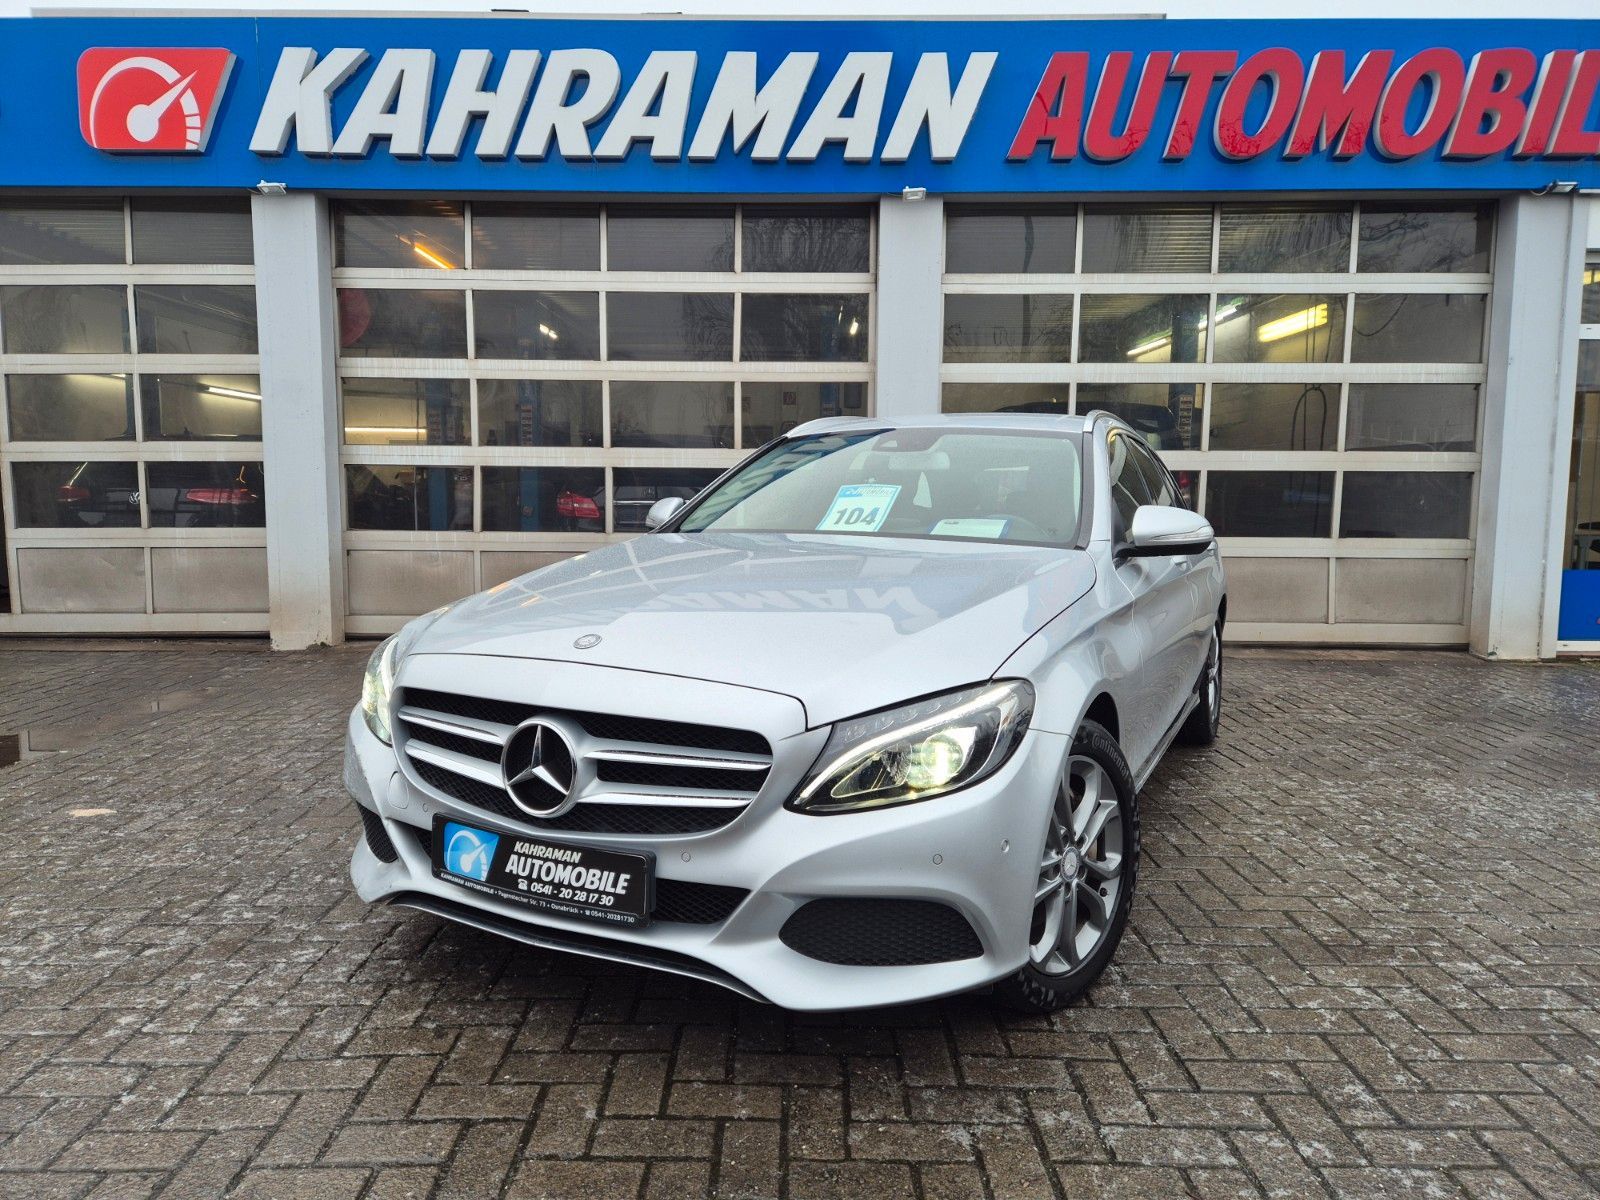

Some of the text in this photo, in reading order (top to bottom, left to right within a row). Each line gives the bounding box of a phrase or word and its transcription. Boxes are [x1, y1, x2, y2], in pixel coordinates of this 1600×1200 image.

[249, 46, 1600, 161] KAHRAMAN AUTOMOBIL
[833, 505, 881, 526] 104
[1091, 732, 1129, 779] Continental
[513, 841, 582, 864] KAHRAMAN
[440, 872, 464, 885] KAHRAMAN
[464, 881, 495, 894] AUTOMOBILE
[551, 903, 579, 914] Osnabrück
[504, 854, 631, 895] AUTOMOBILE
[530, 882, 553, 895] 0541
[558, 888, 573, 899] 20
[573, 891, 587, 902] 28
[588, 893, 599, 903] 17
[599, 895, 614, 906] 30
